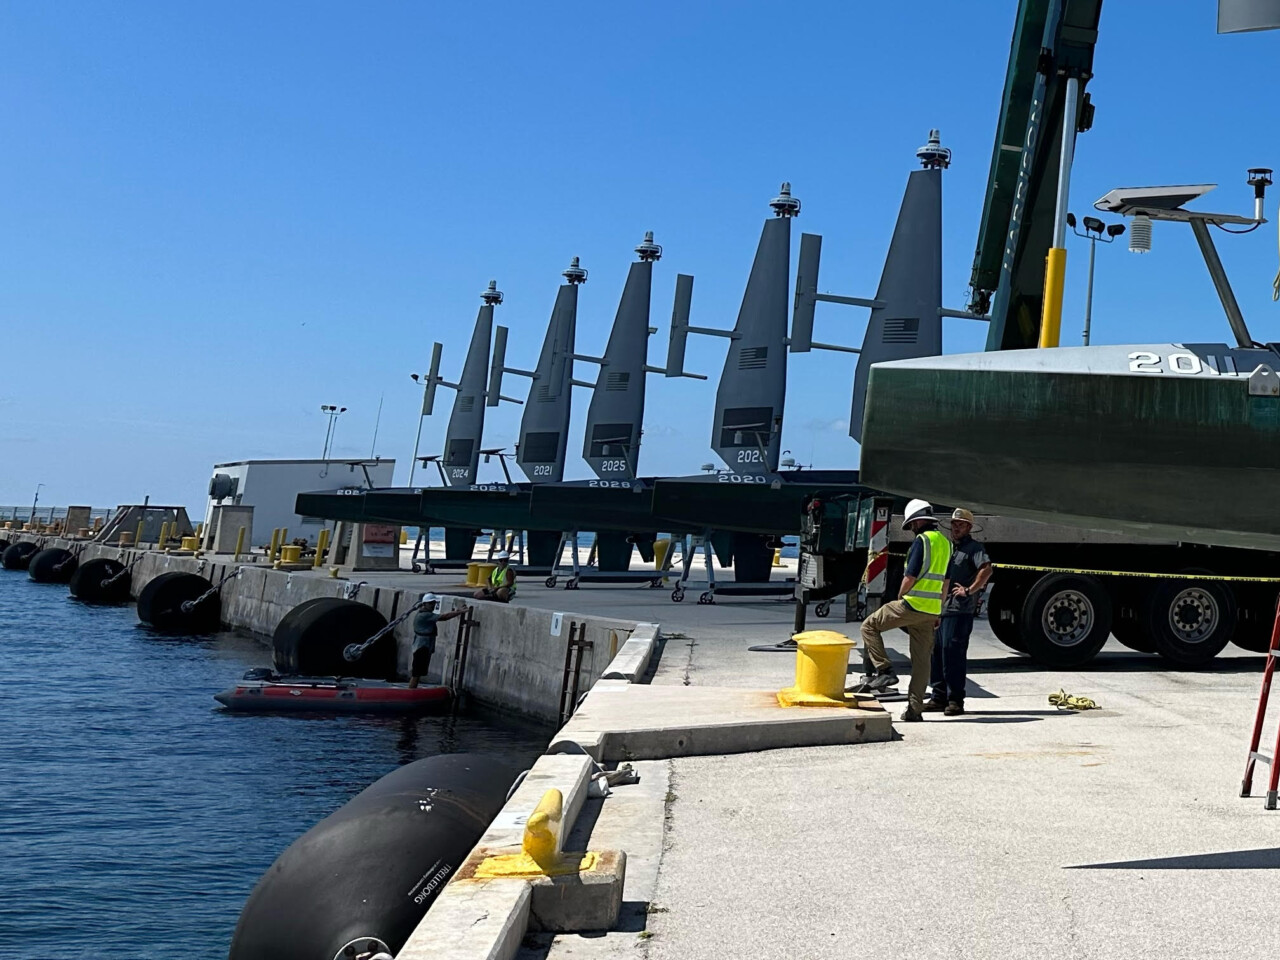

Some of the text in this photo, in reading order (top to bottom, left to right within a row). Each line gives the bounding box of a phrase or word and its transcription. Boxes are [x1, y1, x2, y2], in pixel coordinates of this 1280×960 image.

[1128, 351, 1239, 376] 2011
[533, 465, 553, 476] 2021
[601, 460, 626, 471] 2025
[718, 474, 766, 483] 2020
[414, 863, 453, 904] TRELLEBORG
